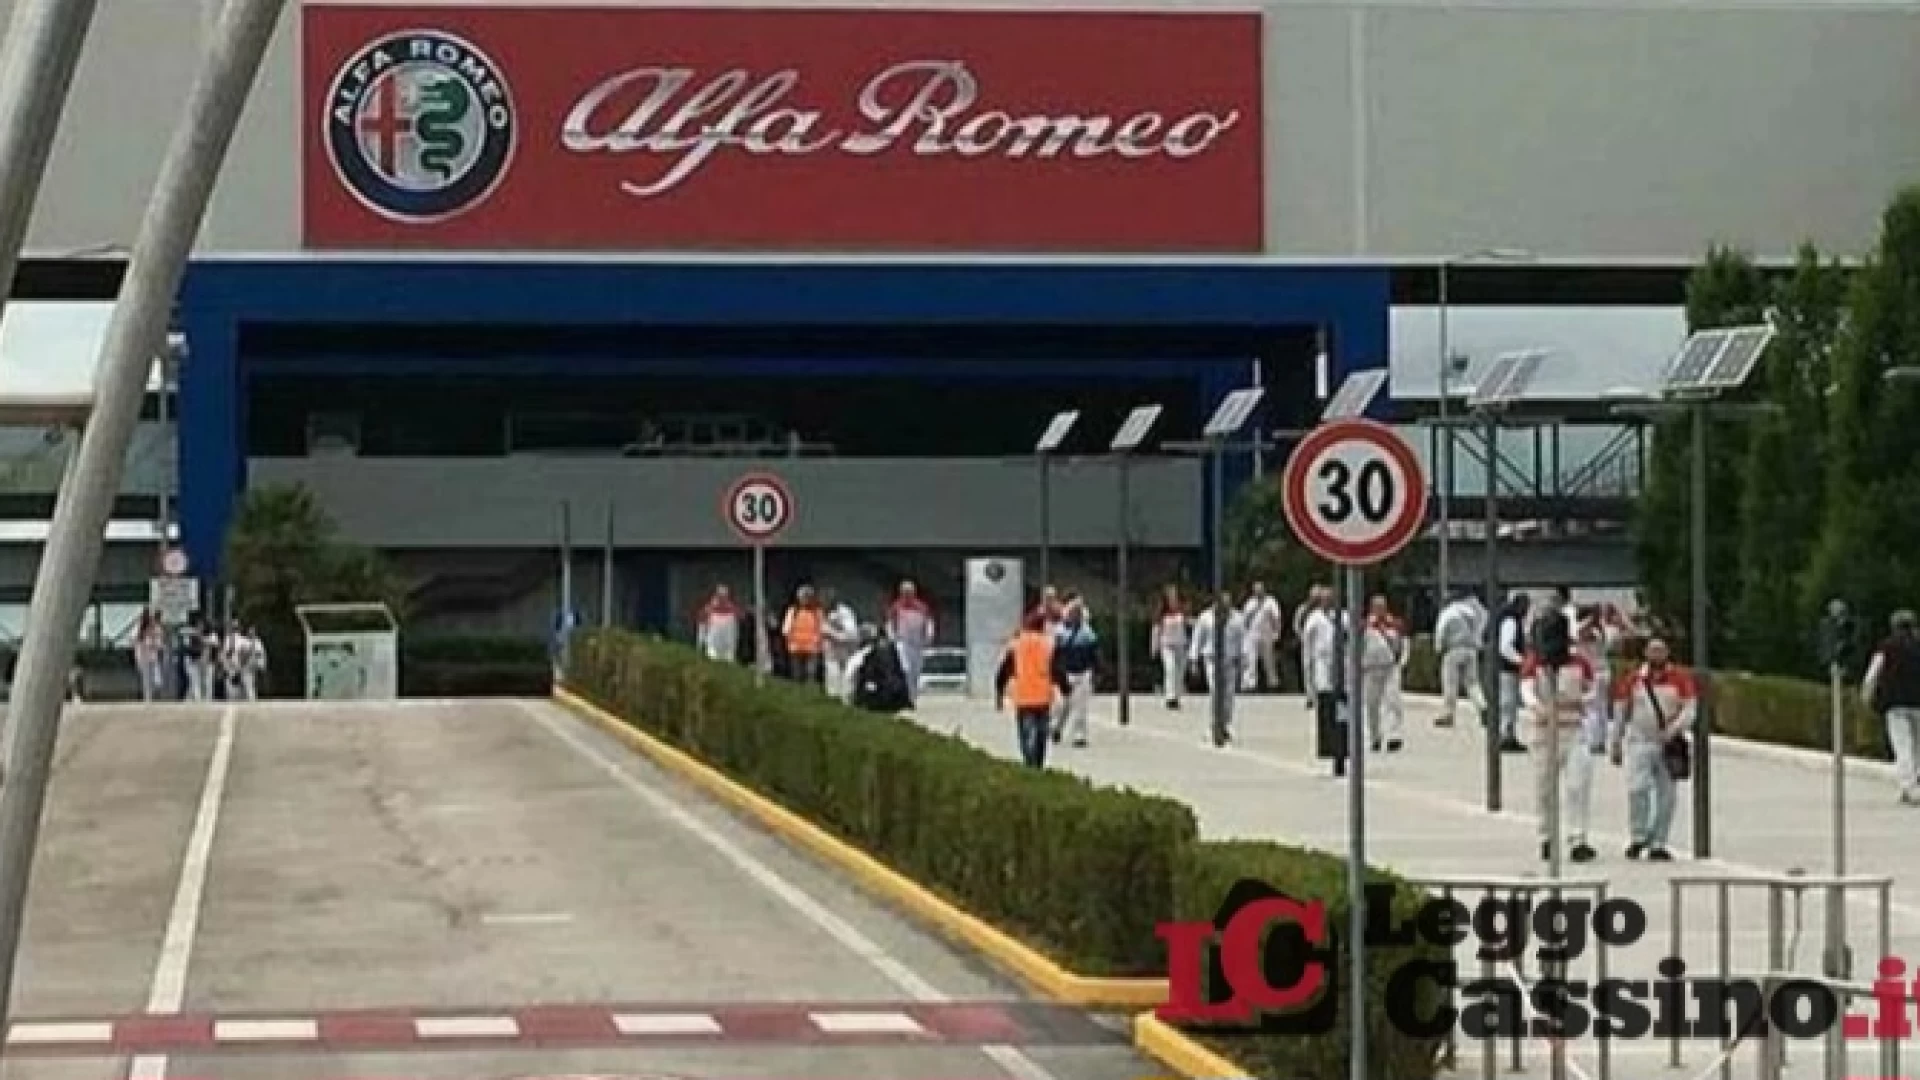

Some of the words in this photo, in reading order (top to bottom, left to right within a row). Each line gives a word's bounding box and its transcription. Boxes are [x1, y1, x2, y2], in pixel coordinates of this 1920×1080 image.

[333, 49, 393, 127] ALFA
[409, 38, 509, 130] ROMEO
[560, 67, 843, 196] Alfa
[839, 59, 1239, 158] Romeo
[741, 492, 778, 524] 30
[1318, 459, 1393, 523] 30
